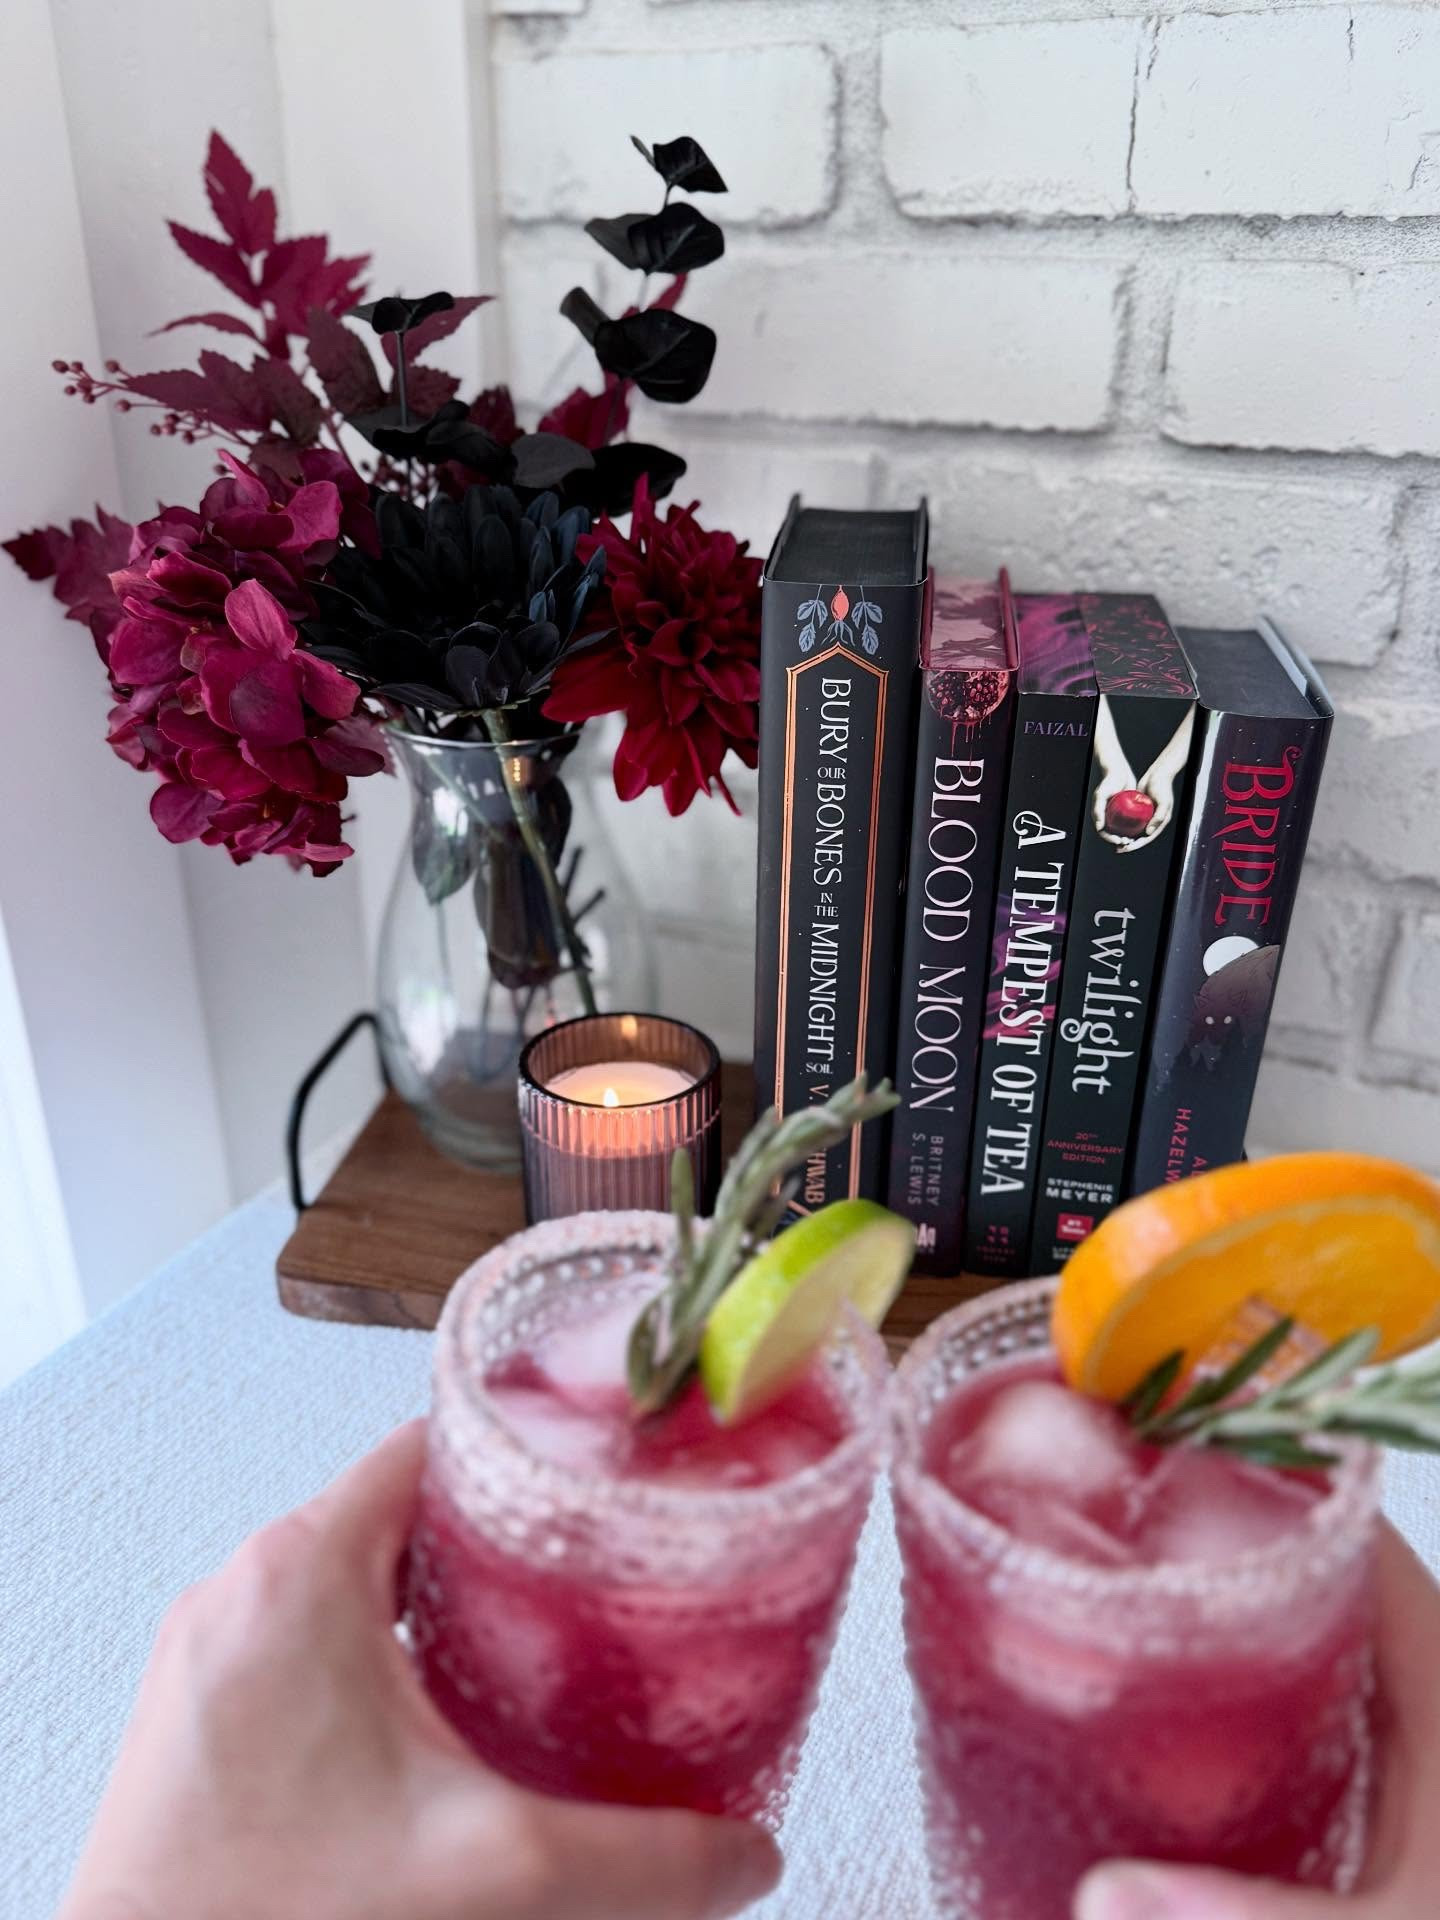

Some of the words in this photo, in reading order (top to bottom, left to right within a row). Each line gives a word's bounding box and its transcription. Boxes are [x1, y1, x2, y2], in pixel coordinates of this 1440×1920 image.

[819, 677, 852, 763] BURY
[1023, 720, 1089, 738] FAIZAL
[817, 766, 846, 780] OUR
[813, 782, 846, 886] BONES
[922, 757, 985, 942] BLOOD
[1012, 810, 1067, 850] A
[1210, 745, 1302, 928] BRIDE
[814, 905, 839, 917] THE
[820, 892, 833, 904] IN
[996, 862, 1065, 1055] TEMPEST
[807, 922, 839, 1062] MIDNIGHT
[1060, 909, 1143, 1095] twilight
[909, 963, 966, 1112] MOON
[805, 1062, 834, 1075] SOIL
[991, 1064, 1038, 1114] OF
[911, 1132, 926, 1147] S.
[980, 1122, 1033, 1195] TEA
[1047, 1139, 1124, 1154] ANNIVERSARY
[1062, 1151, 1106, 1165] EDITION
[907, 1155, 925, 1205] LEWIS
[925, 1135, 945, 1206] BRITNEY
[1045, 1186, 1114, 1204] MEYER
[1047, 1177, 1114, 1192] STEPHENIE
